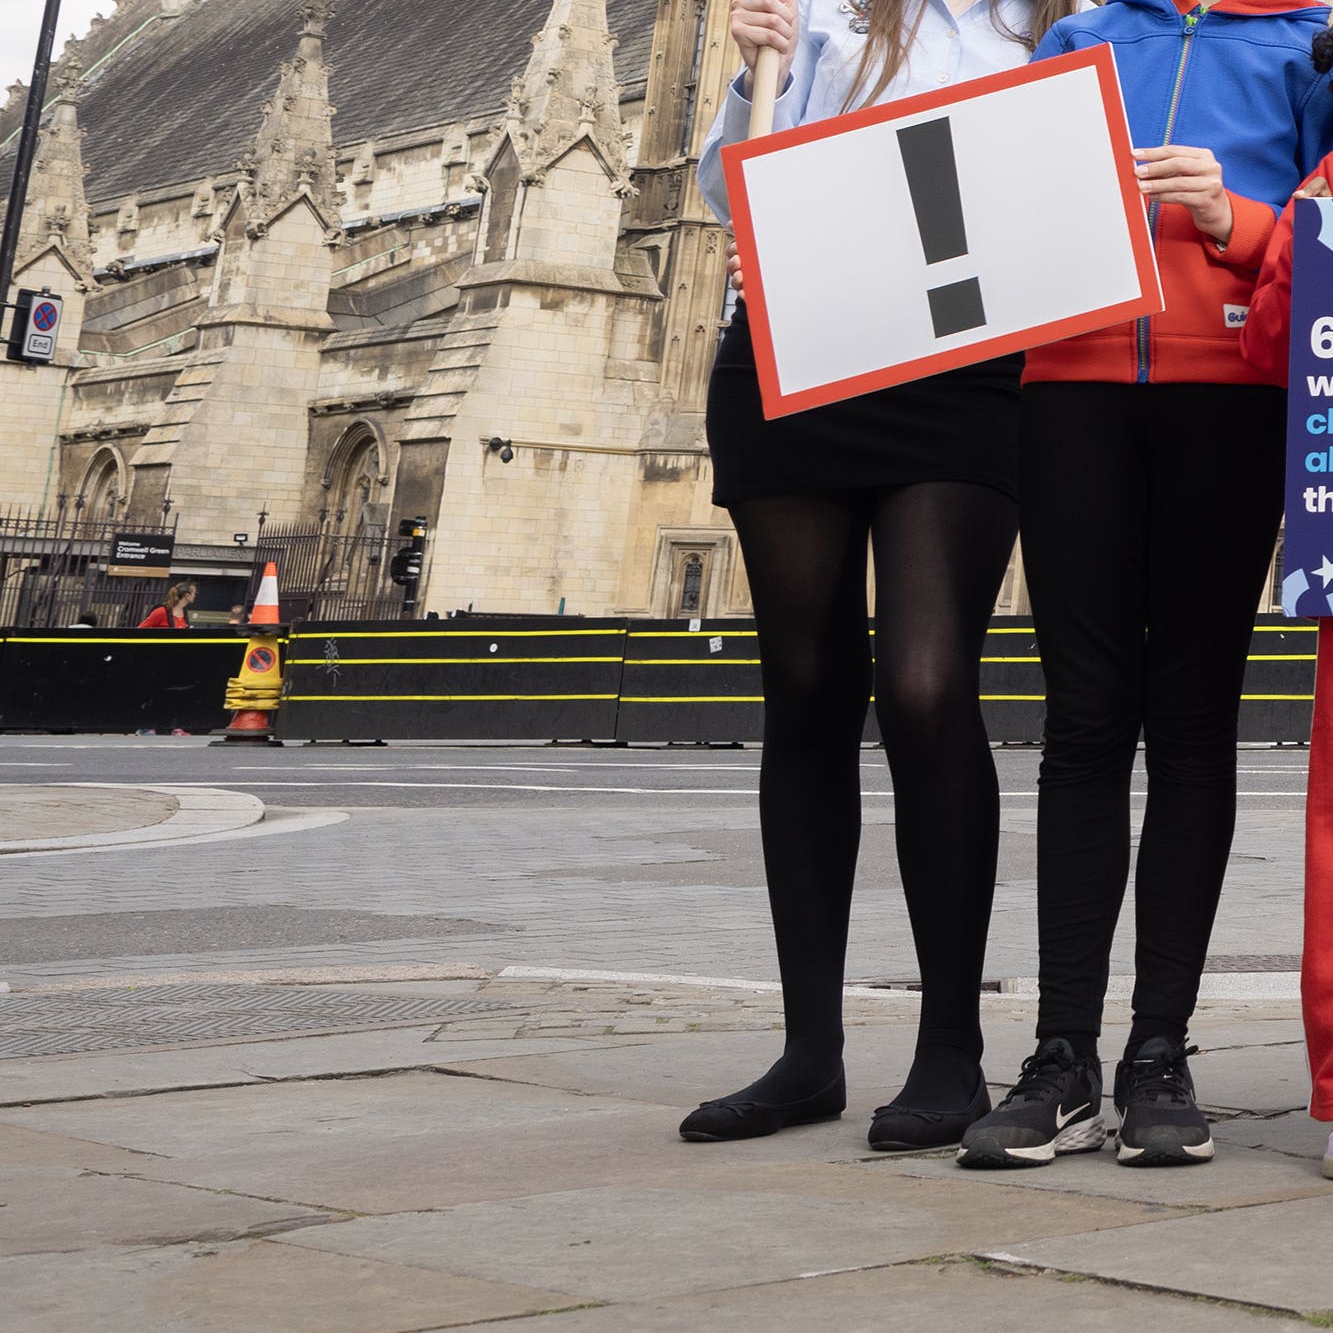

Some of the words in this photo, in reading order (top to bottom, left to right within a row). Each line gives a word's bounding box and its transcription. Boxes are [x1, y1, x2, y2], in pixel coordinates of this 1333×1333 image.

[896, 115, 987, 338] !
[32, 339, 48, 349] End
[116, 551, 146, 559] Entrance
[117, 546, 149, 554] Cromwell
[149, 547, 170, 555] Green
